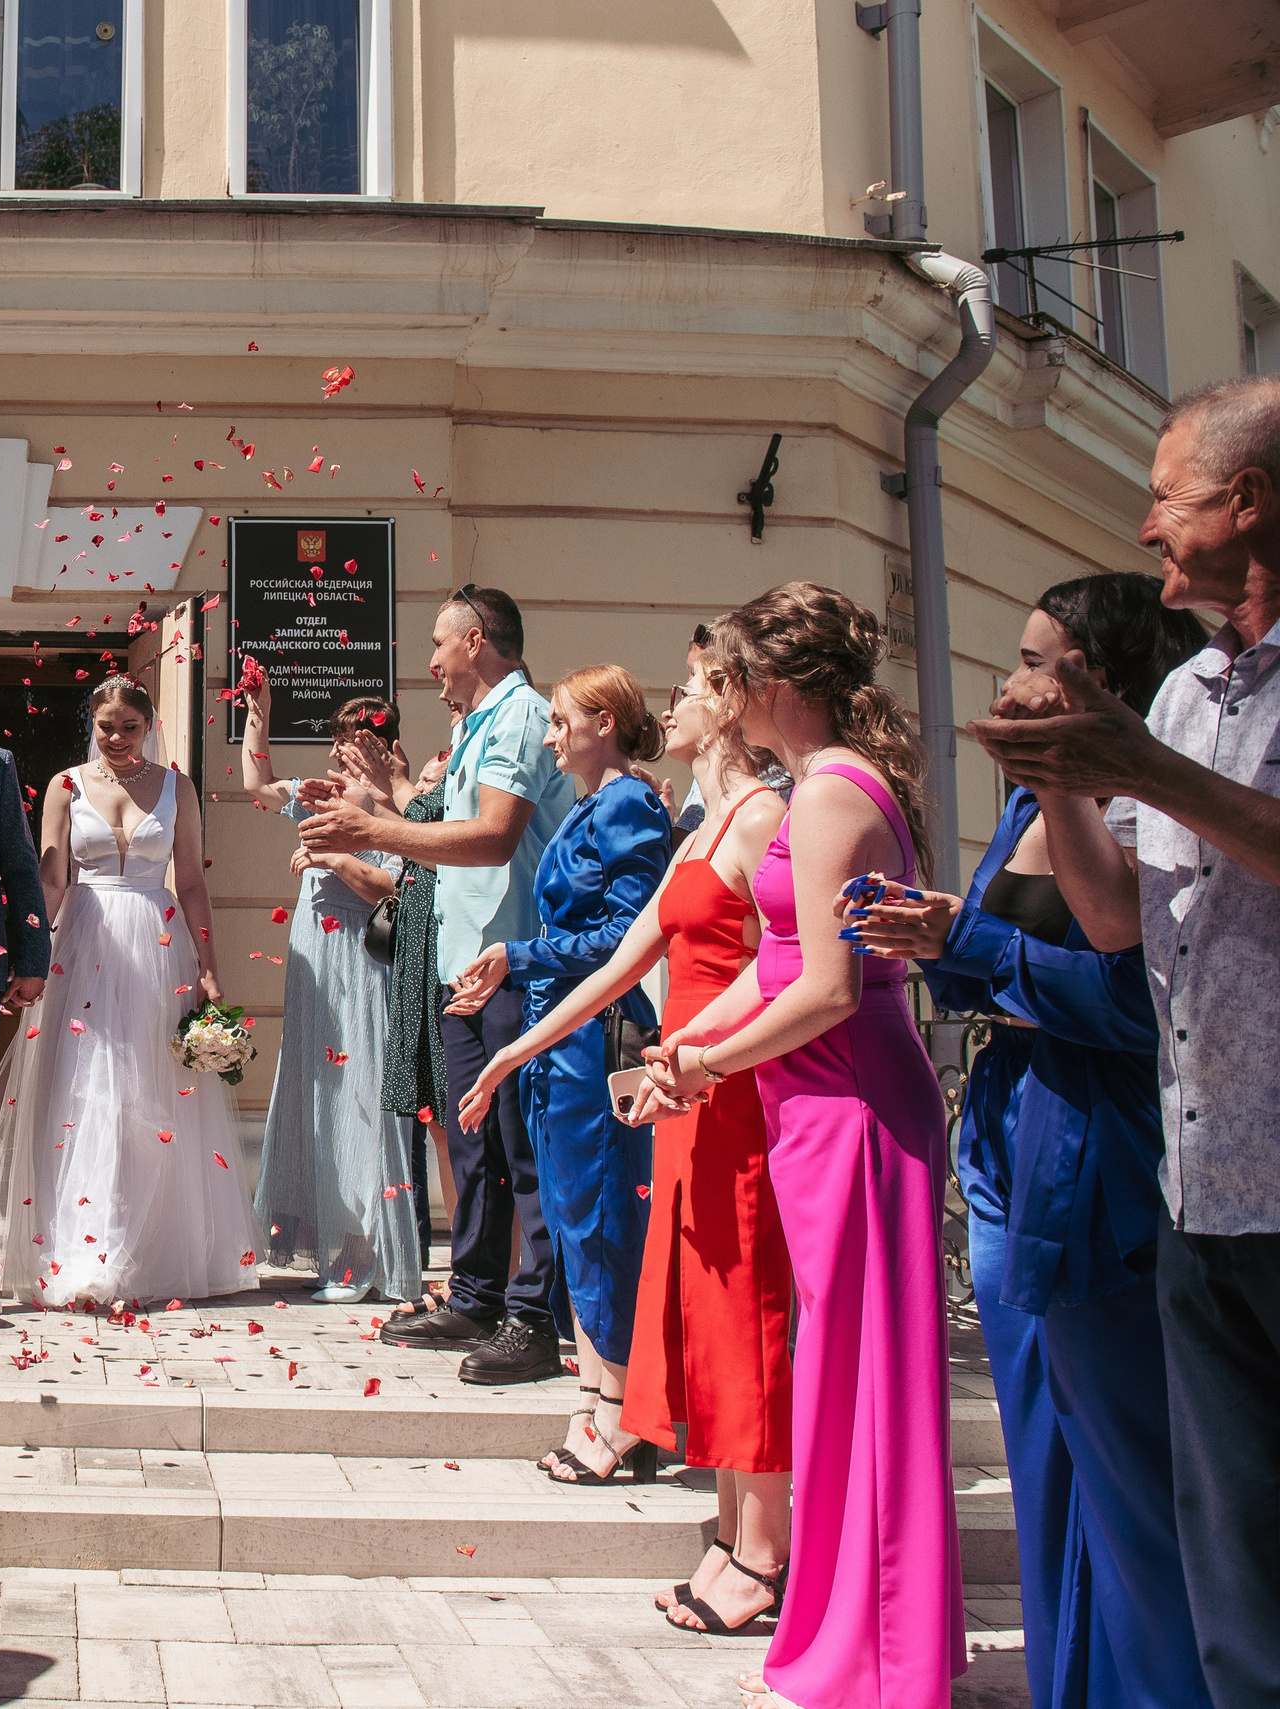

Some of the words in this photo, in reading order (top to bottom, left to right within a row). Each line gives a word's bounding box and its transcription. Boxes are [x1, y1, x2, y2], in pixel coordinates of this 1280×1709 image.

[250, 579, 314, 589] РОССИЙСКАЯ
[316, 579, 373, 590] ФЕДЕРАЦИЯ
[295, 616, 327, 626] ОТДЕЛ
[275, 628, 313, 638] ЗАПИСИ
[242, 641, 320, 651] ГРАЖДАНСКОГО
[322, 641, 381, 651] СОСОЯНИЯ
[269, 665, 354, 676] АДМИНИСТРАЦИИ
[291, 678, 384, 689] МУНИЦИПАЛЬНОГО
[292, 689, 331, 699] РАЙОНА
